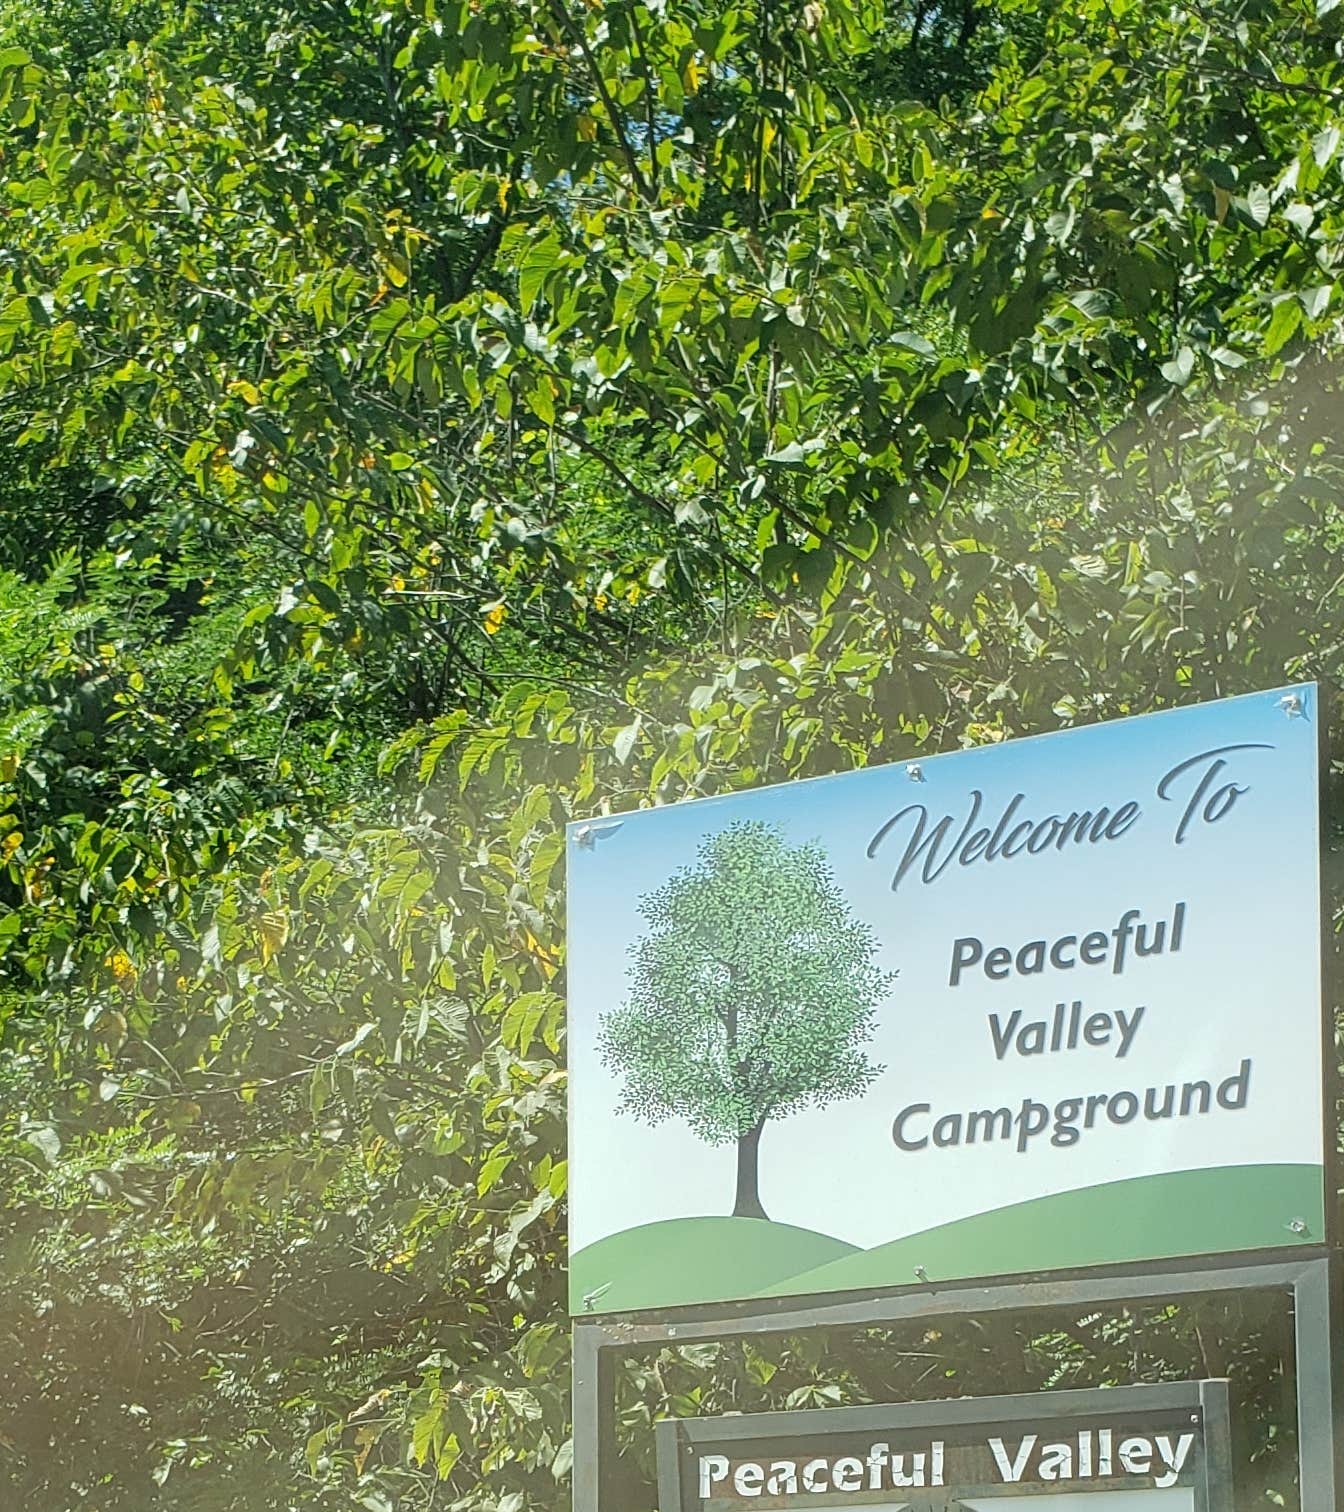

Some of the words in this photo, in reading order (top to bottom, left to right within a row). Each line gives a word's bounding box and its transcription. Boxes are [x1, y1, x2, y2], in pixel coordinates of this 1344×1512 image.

[866, 789, 1140, 892] Welcome
[1157, 743, 1276, 843] To
[949, 902, 1186, 985] Peaceful
[987, 1001, 1146, 1059] Valley
[891, 1058, 1252, 1153] Campground
[698, 1441, 945, 1499] Peaceful
[987, 1429, 1194, 1487] Valley
